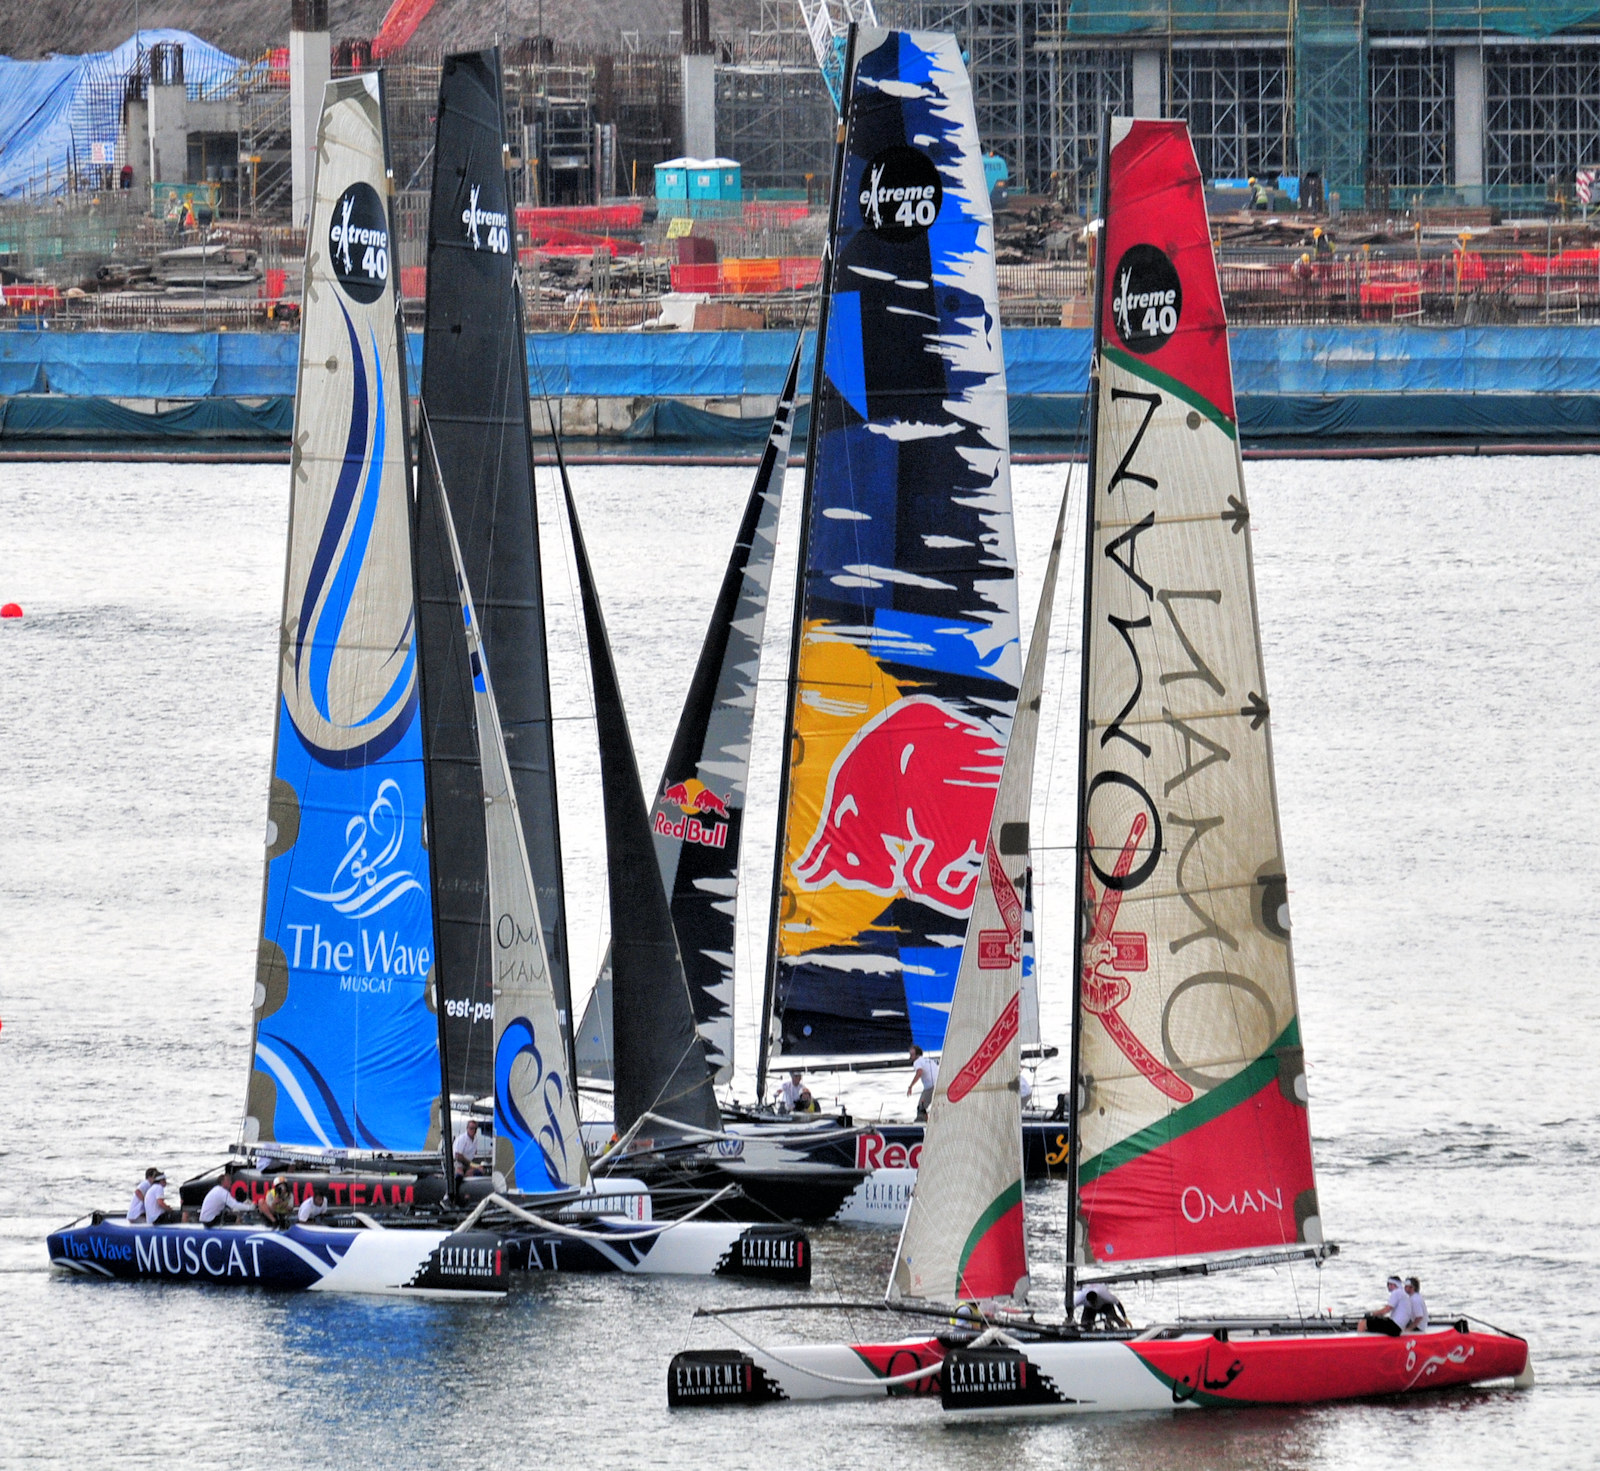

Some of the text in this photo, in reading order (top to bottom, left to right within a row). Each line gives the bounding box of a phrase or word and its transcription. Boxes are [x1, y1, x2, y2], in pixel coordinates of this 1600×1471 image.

[895, 200, 936, 228] 40
[487, 227, 508, 254] 40
[362, 247, 388, 280] 40
[1142, 305, 1177, 336] 40
[653, 810, 728, 848] Red Bull
[286, 923, 430, 976] The Wave
[340, 974, 394, 994] MUSCAT
[328, 1182, 415, 1206] TEAM
[60, 1234, 264, 1277] The Wave MUSCAT
[439, 1247, 493, 1268] EXTREME
[742, 1239, 794, 1260] EXTREME
[440, 1267, 493, 1276] SAILING SERIES
[742, 1259, 794, 1268] SAILING SERIES
[676, 1364, 742, 1387] EXTREME
[950, 1361, 1016, 1385] EXTREME
[677, 1384, 742, 1396] SAILING SERIES
[951, 1381, 1017, 1393] SAILING SERIES
